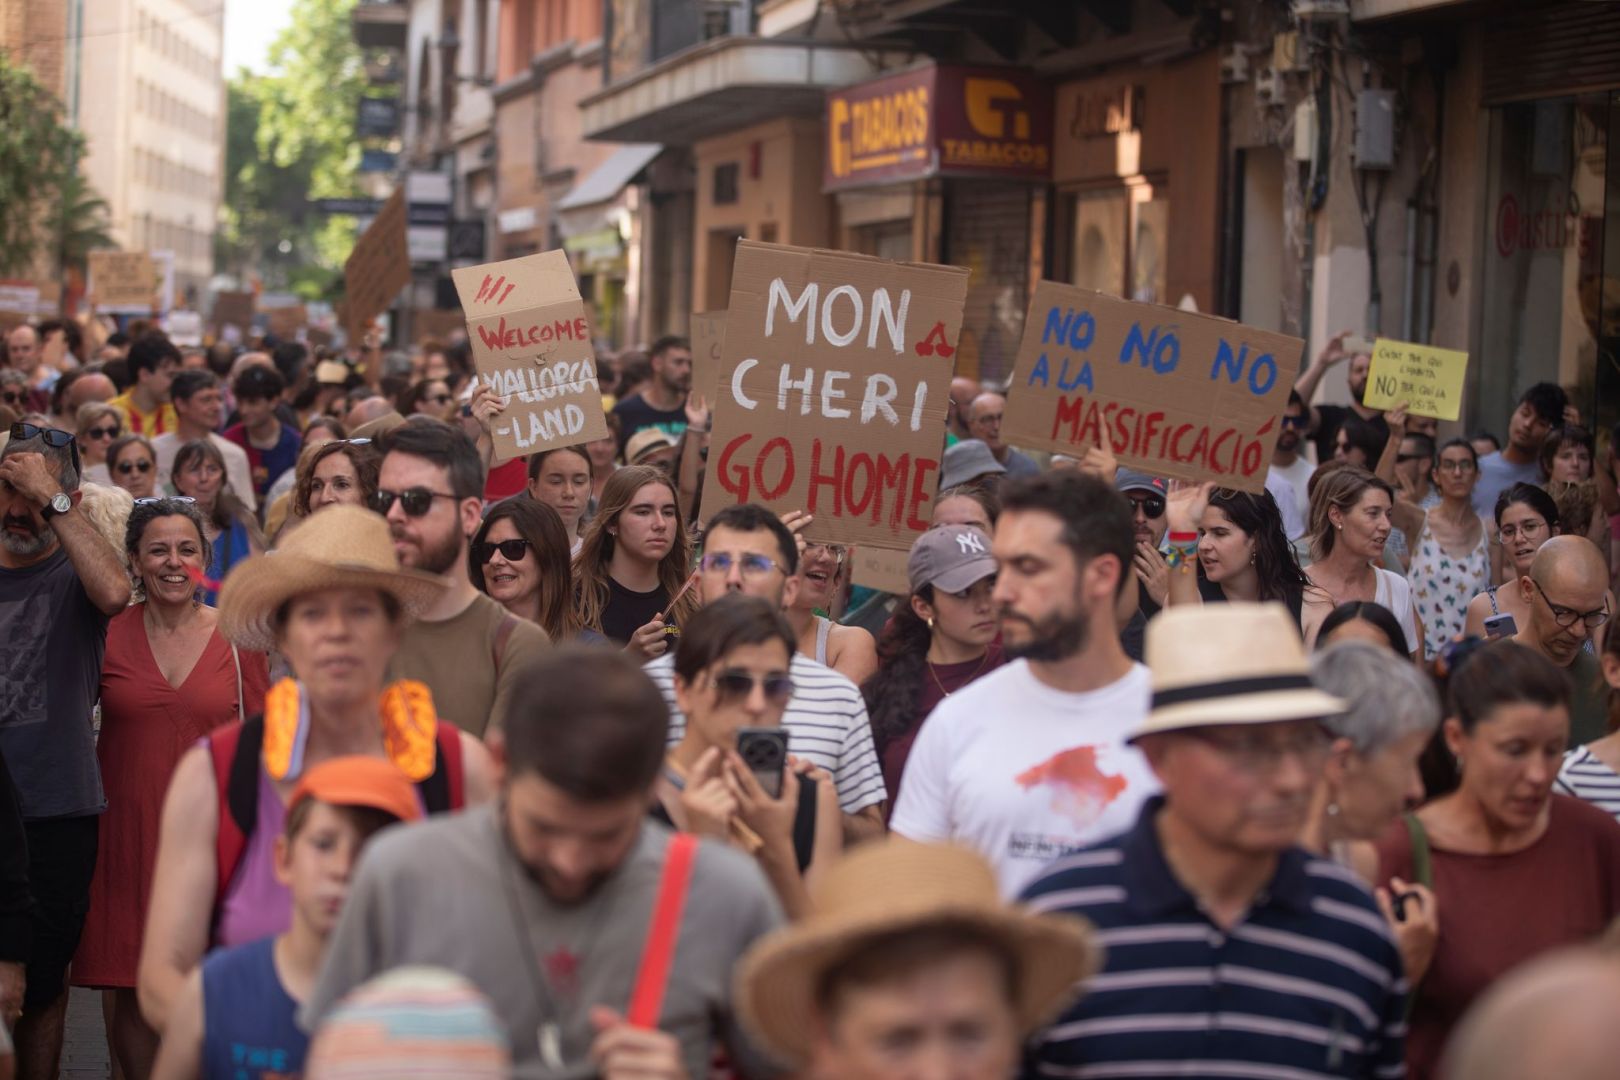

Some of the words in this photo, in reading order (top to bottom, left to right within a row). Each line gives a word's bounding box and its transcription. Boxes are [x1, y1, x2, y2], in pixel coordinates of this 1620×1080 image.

[852, 88, 928, 153] TABACOS
[942, 139, 1047, 168] TABACOS
[477, 317, 589, 350] WELCOME
[764, 276, 911, 355] MON
[1028, 352, 1049, 388] A
[1056, 356, 1095, 393] LA
[1041, 306, 1096, 351] NO
[1119, 320, 1181, 375] NO
[1210, 337, 1278, 396] NO
[483, 358, 599, 408] MALLORCA
[731, 358, 928, 432] CHERI
[1375, 374, 1398, 398] NO
[497, 404, 585, 448] -LAND
[1051, 395, 1277, 477] MASSIFICACIÓ
[716, 433, 796, 505] GO
[807, 437, 938, 535] HOME
[956, 532, 985, 554] NY
